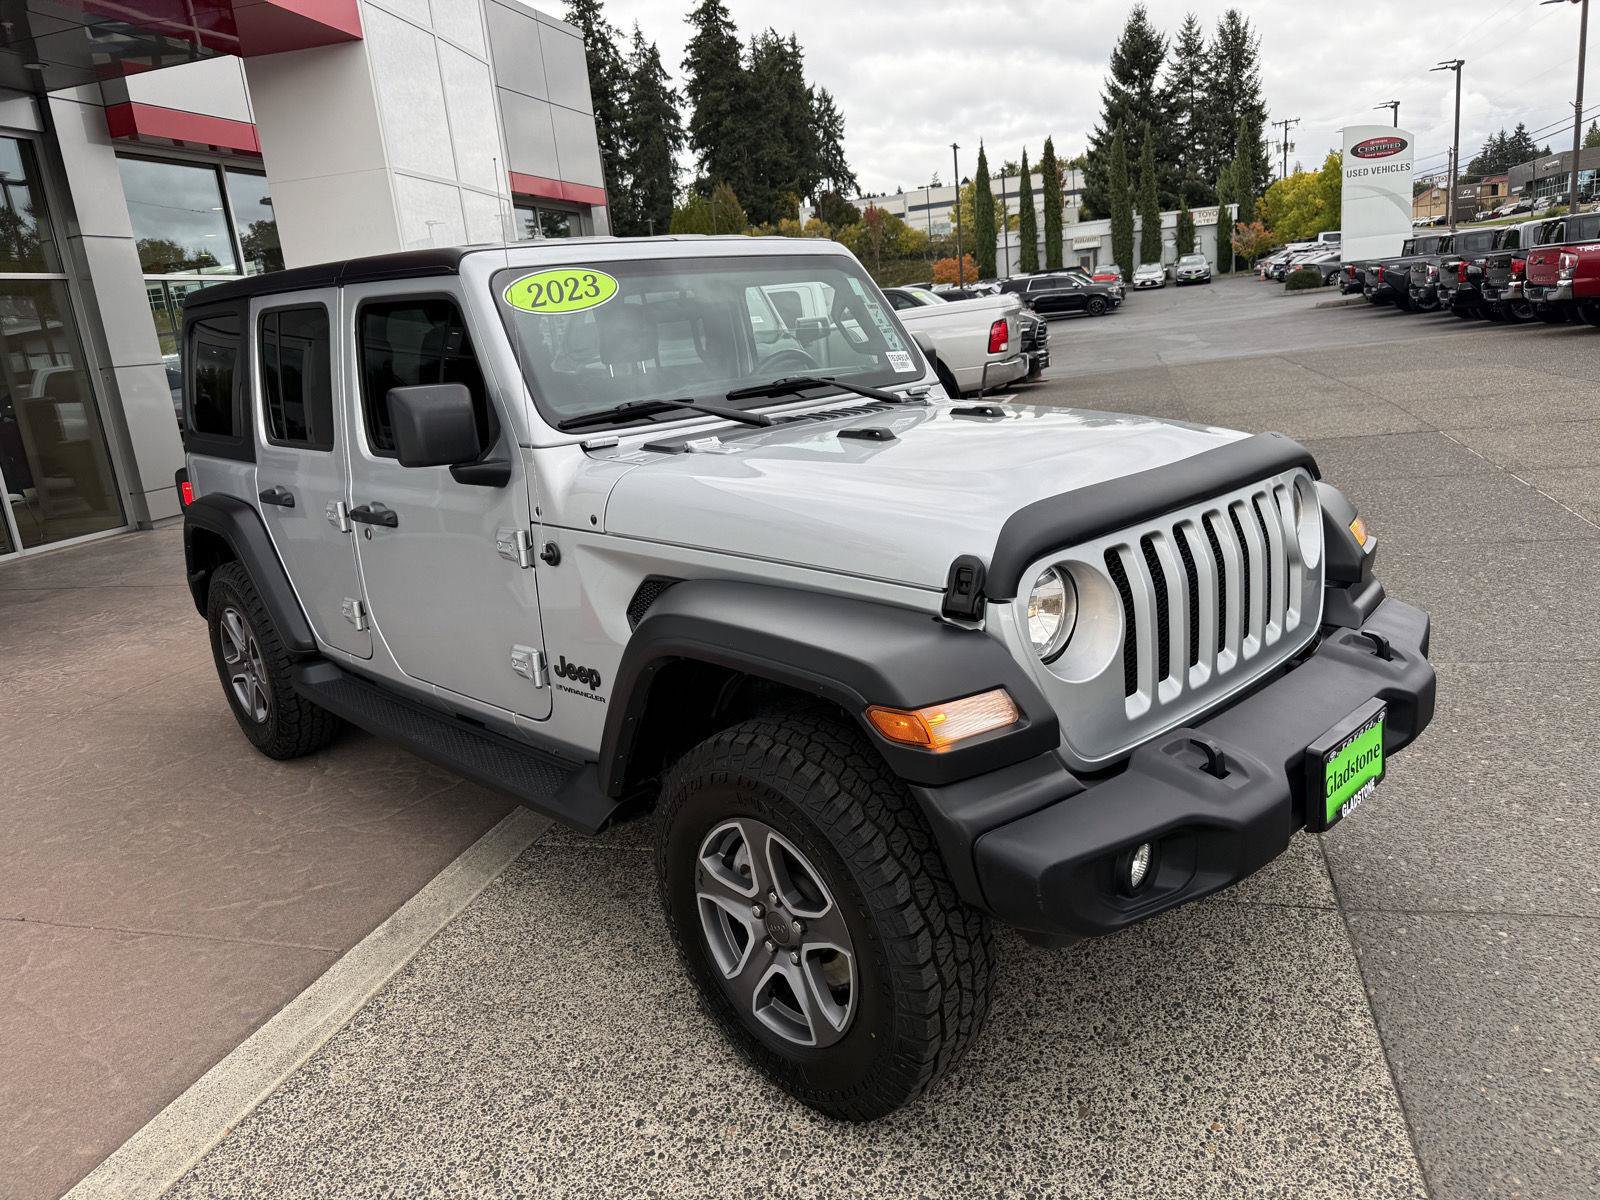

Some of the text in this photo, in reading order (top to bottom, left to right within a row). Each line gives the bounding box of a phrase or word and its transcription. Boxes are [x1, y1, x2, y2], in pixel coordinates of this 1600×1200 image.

[1357, 142, 1401, 154] CERTIFIED
[1346, 162, 1411, 179] USED VEHICLES
[526, 274, 601, 308] 2023
[553, 655, 602, 691] Jeep
[562, 685, 606, 703] WRANGLER
[1325, 743, 1381, 798] Gladstone
[1341, 777, 1376, 817] GLADSTONE
